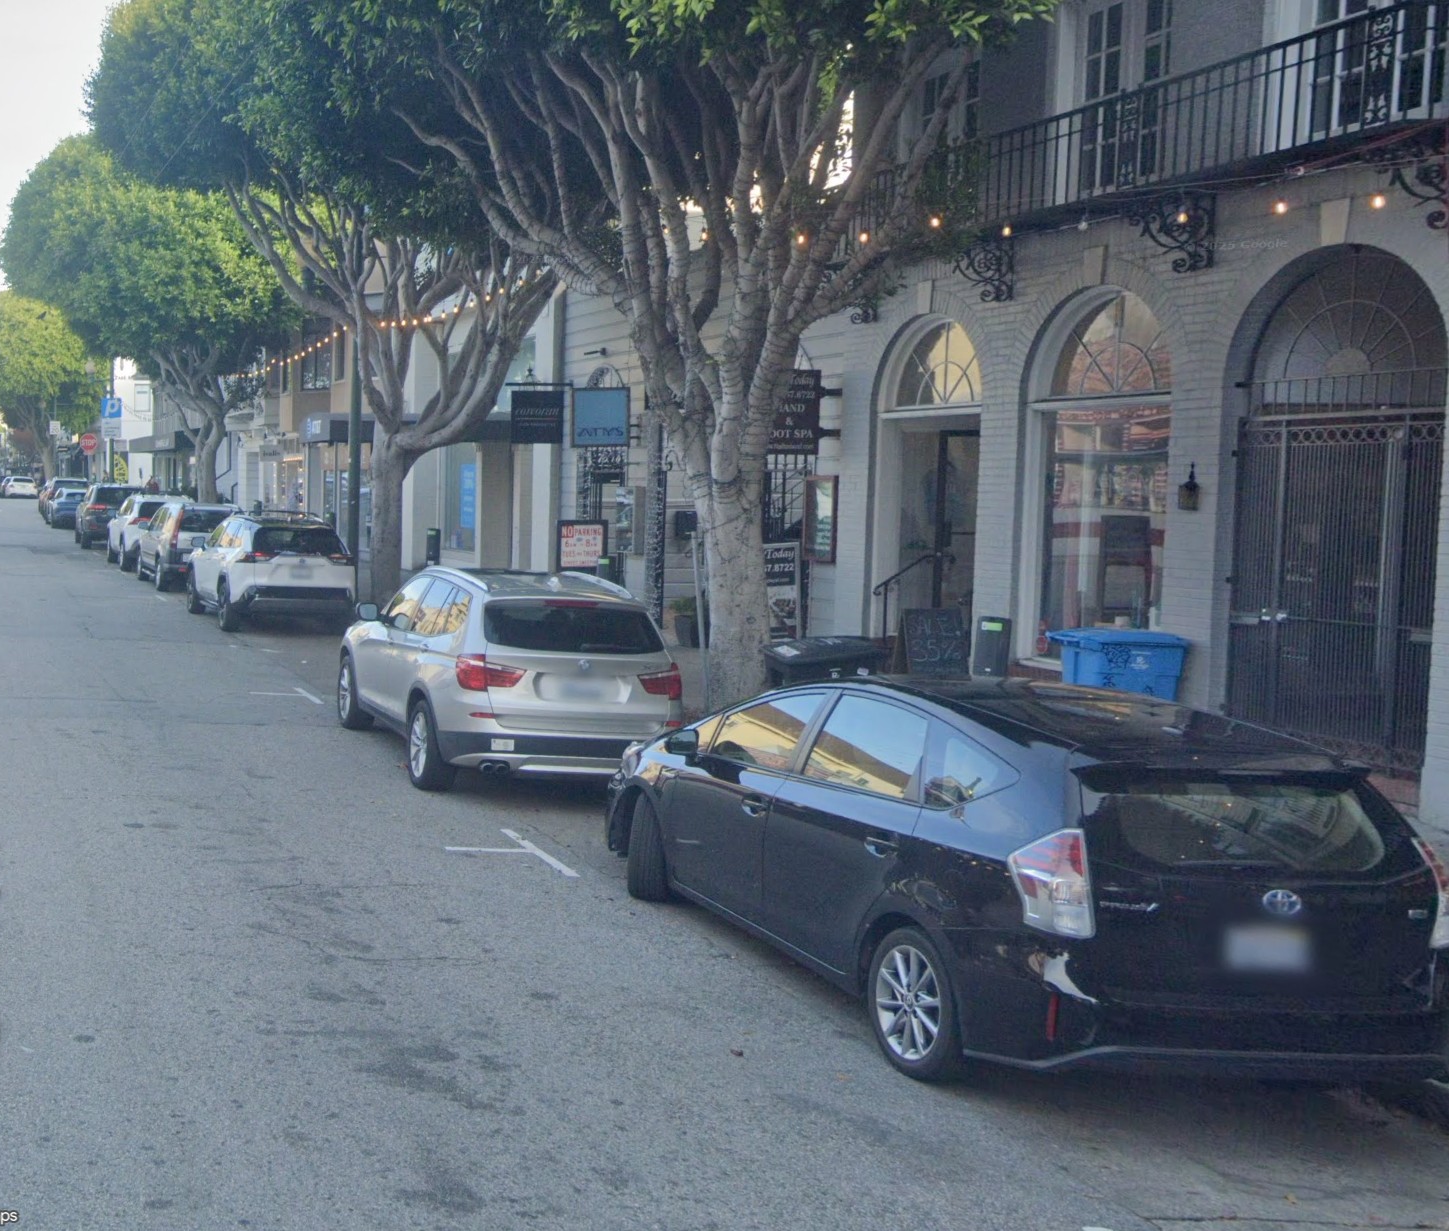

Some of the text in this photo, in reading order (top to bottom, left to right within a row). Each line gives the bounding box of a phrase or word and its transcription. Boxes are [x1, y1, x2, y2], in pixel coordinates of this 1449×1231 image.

[785, 416, 793, 426] &
[794, 429, 813, 438] SPA
[562, 525, 602, 537] NO PARKING
[765, 549, 795, 560] Today
